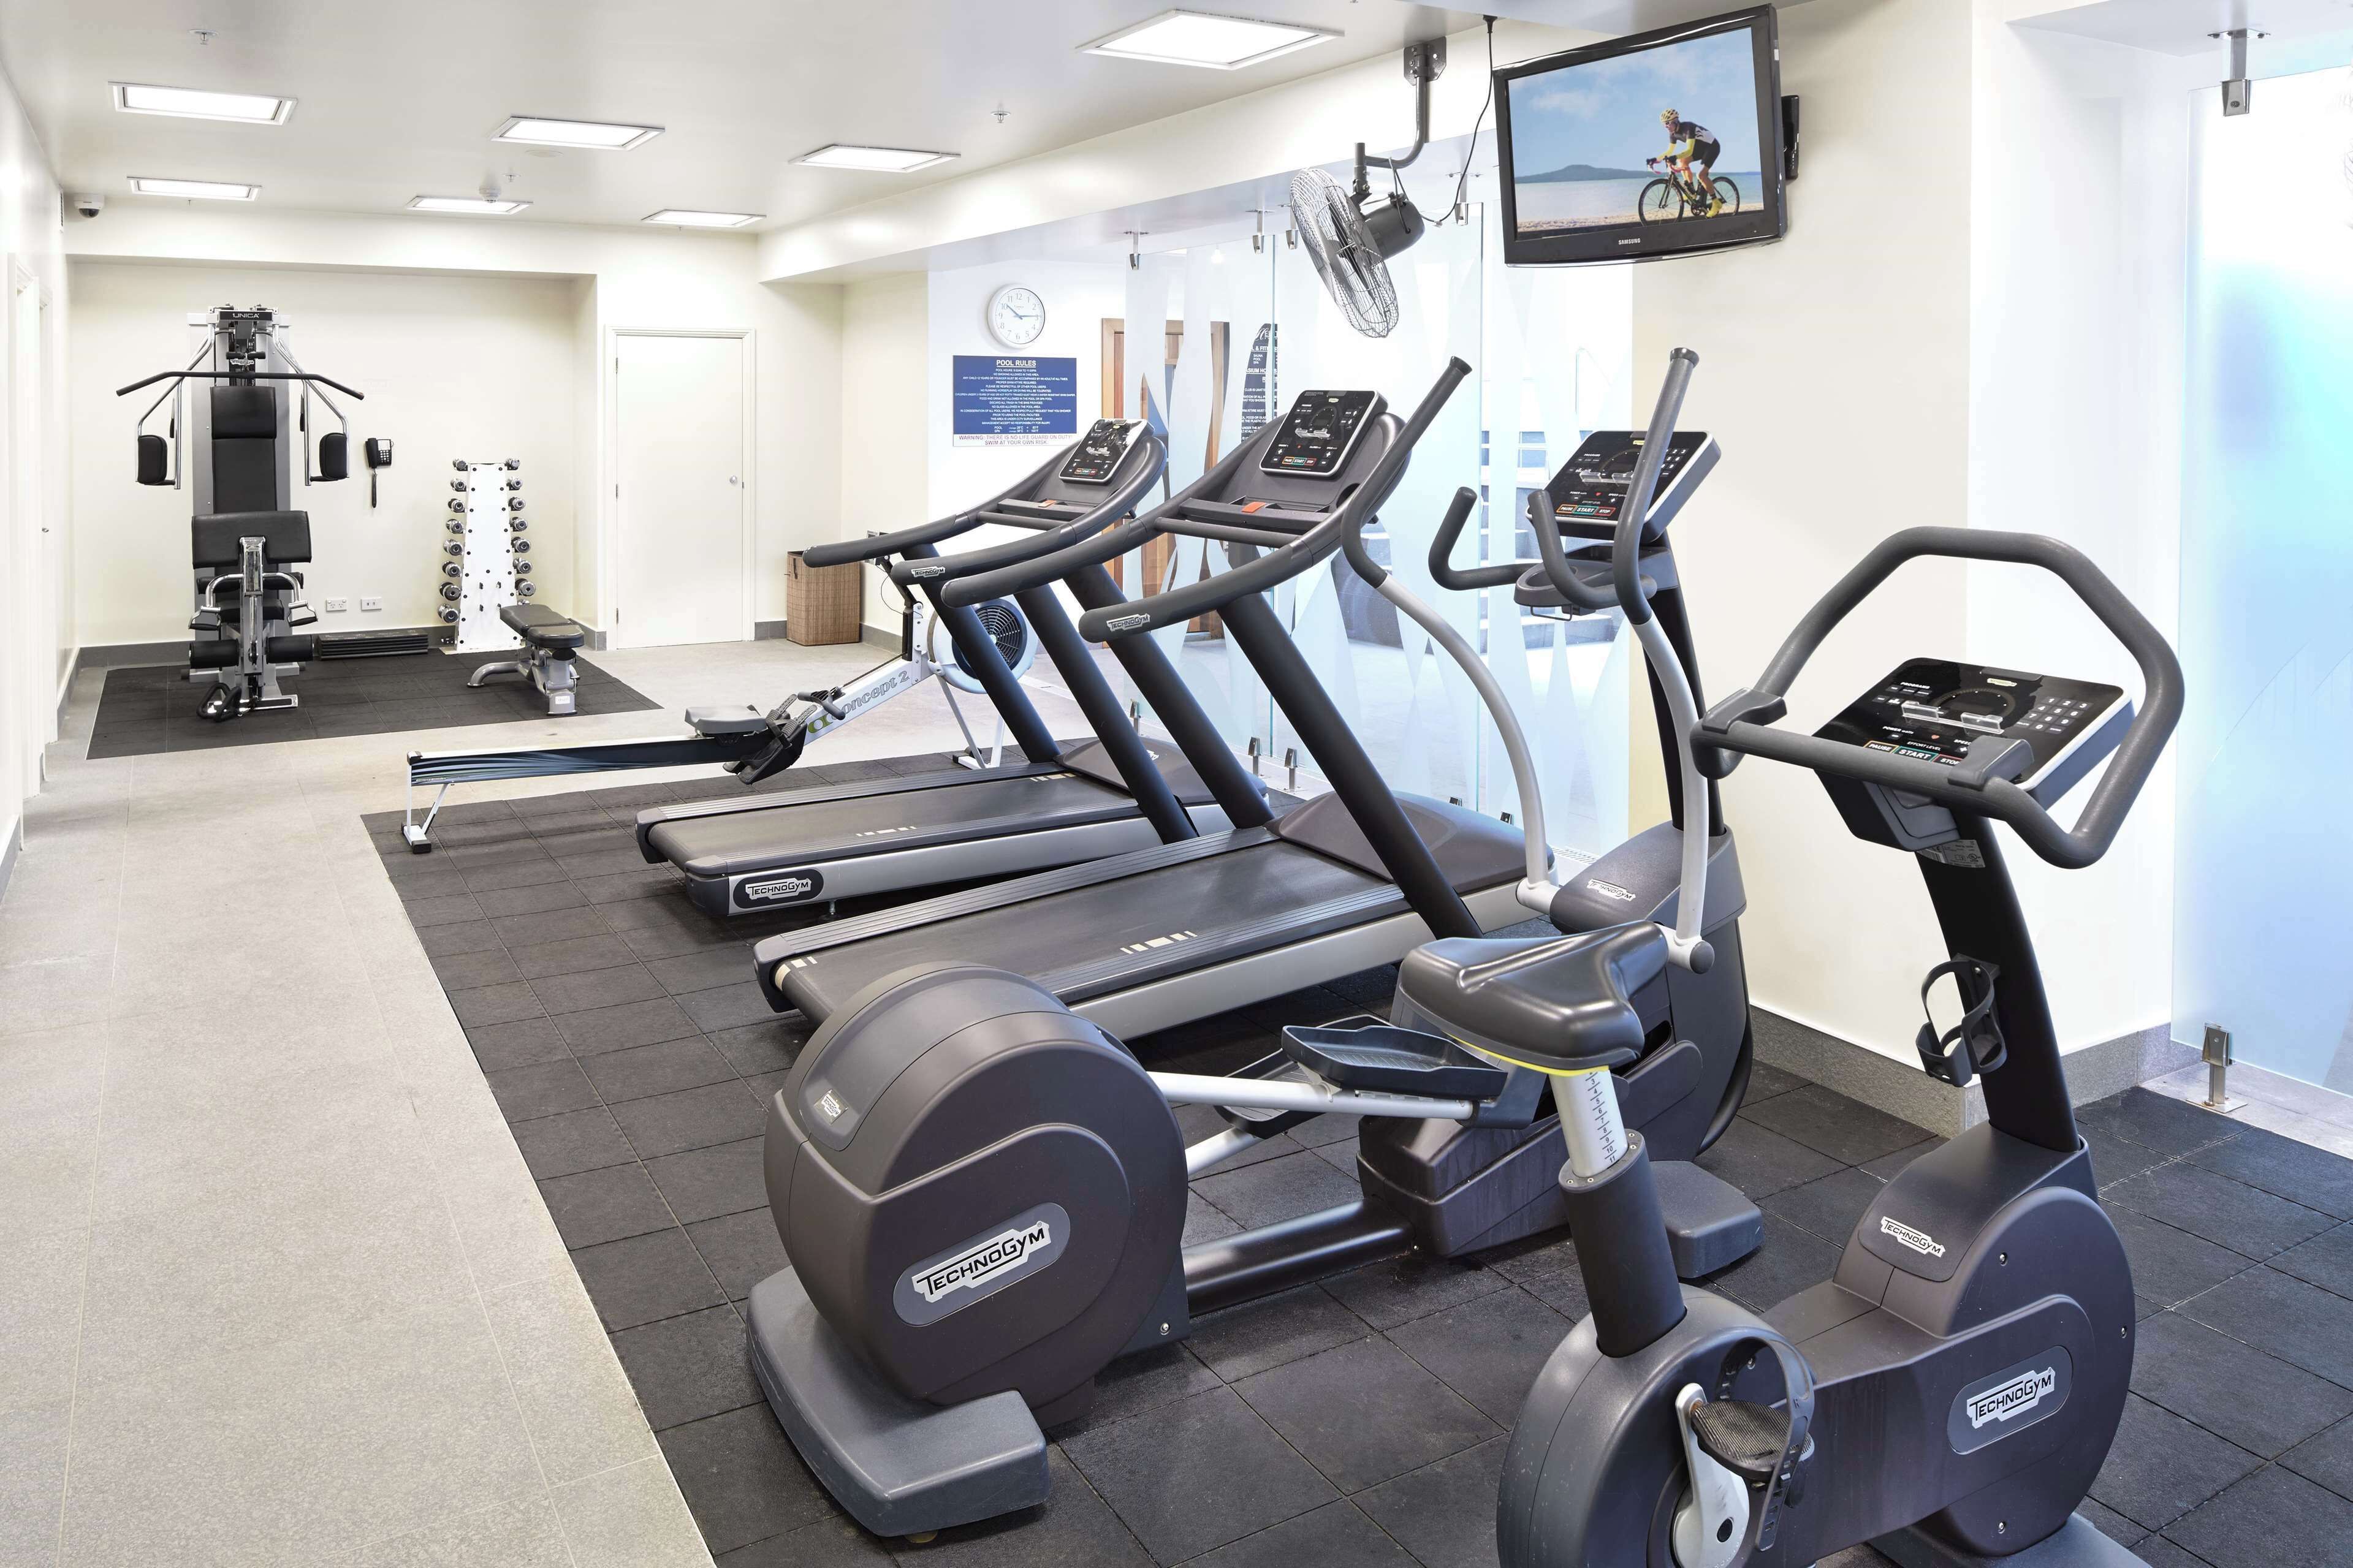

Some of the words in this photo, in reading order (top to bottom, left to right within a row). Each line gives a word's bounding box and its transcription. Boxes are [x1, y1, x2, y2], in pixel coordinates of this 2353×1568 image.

[1108, 616, 1149, 629] TECHNOGYM
[832, 677, 897, 720] oncept
[898, 671, 909, 683] 2
[1899, 749, 1931, 759] START
[748, 882, 808, 896] TECHNOGYM
[1885, 1219, 1941, 1254] TECHNOGYM
[916, 1228, 1045, 1295] TECHNOGYM
[1969, 1374, 2051, 1421] TECHNOGYM
